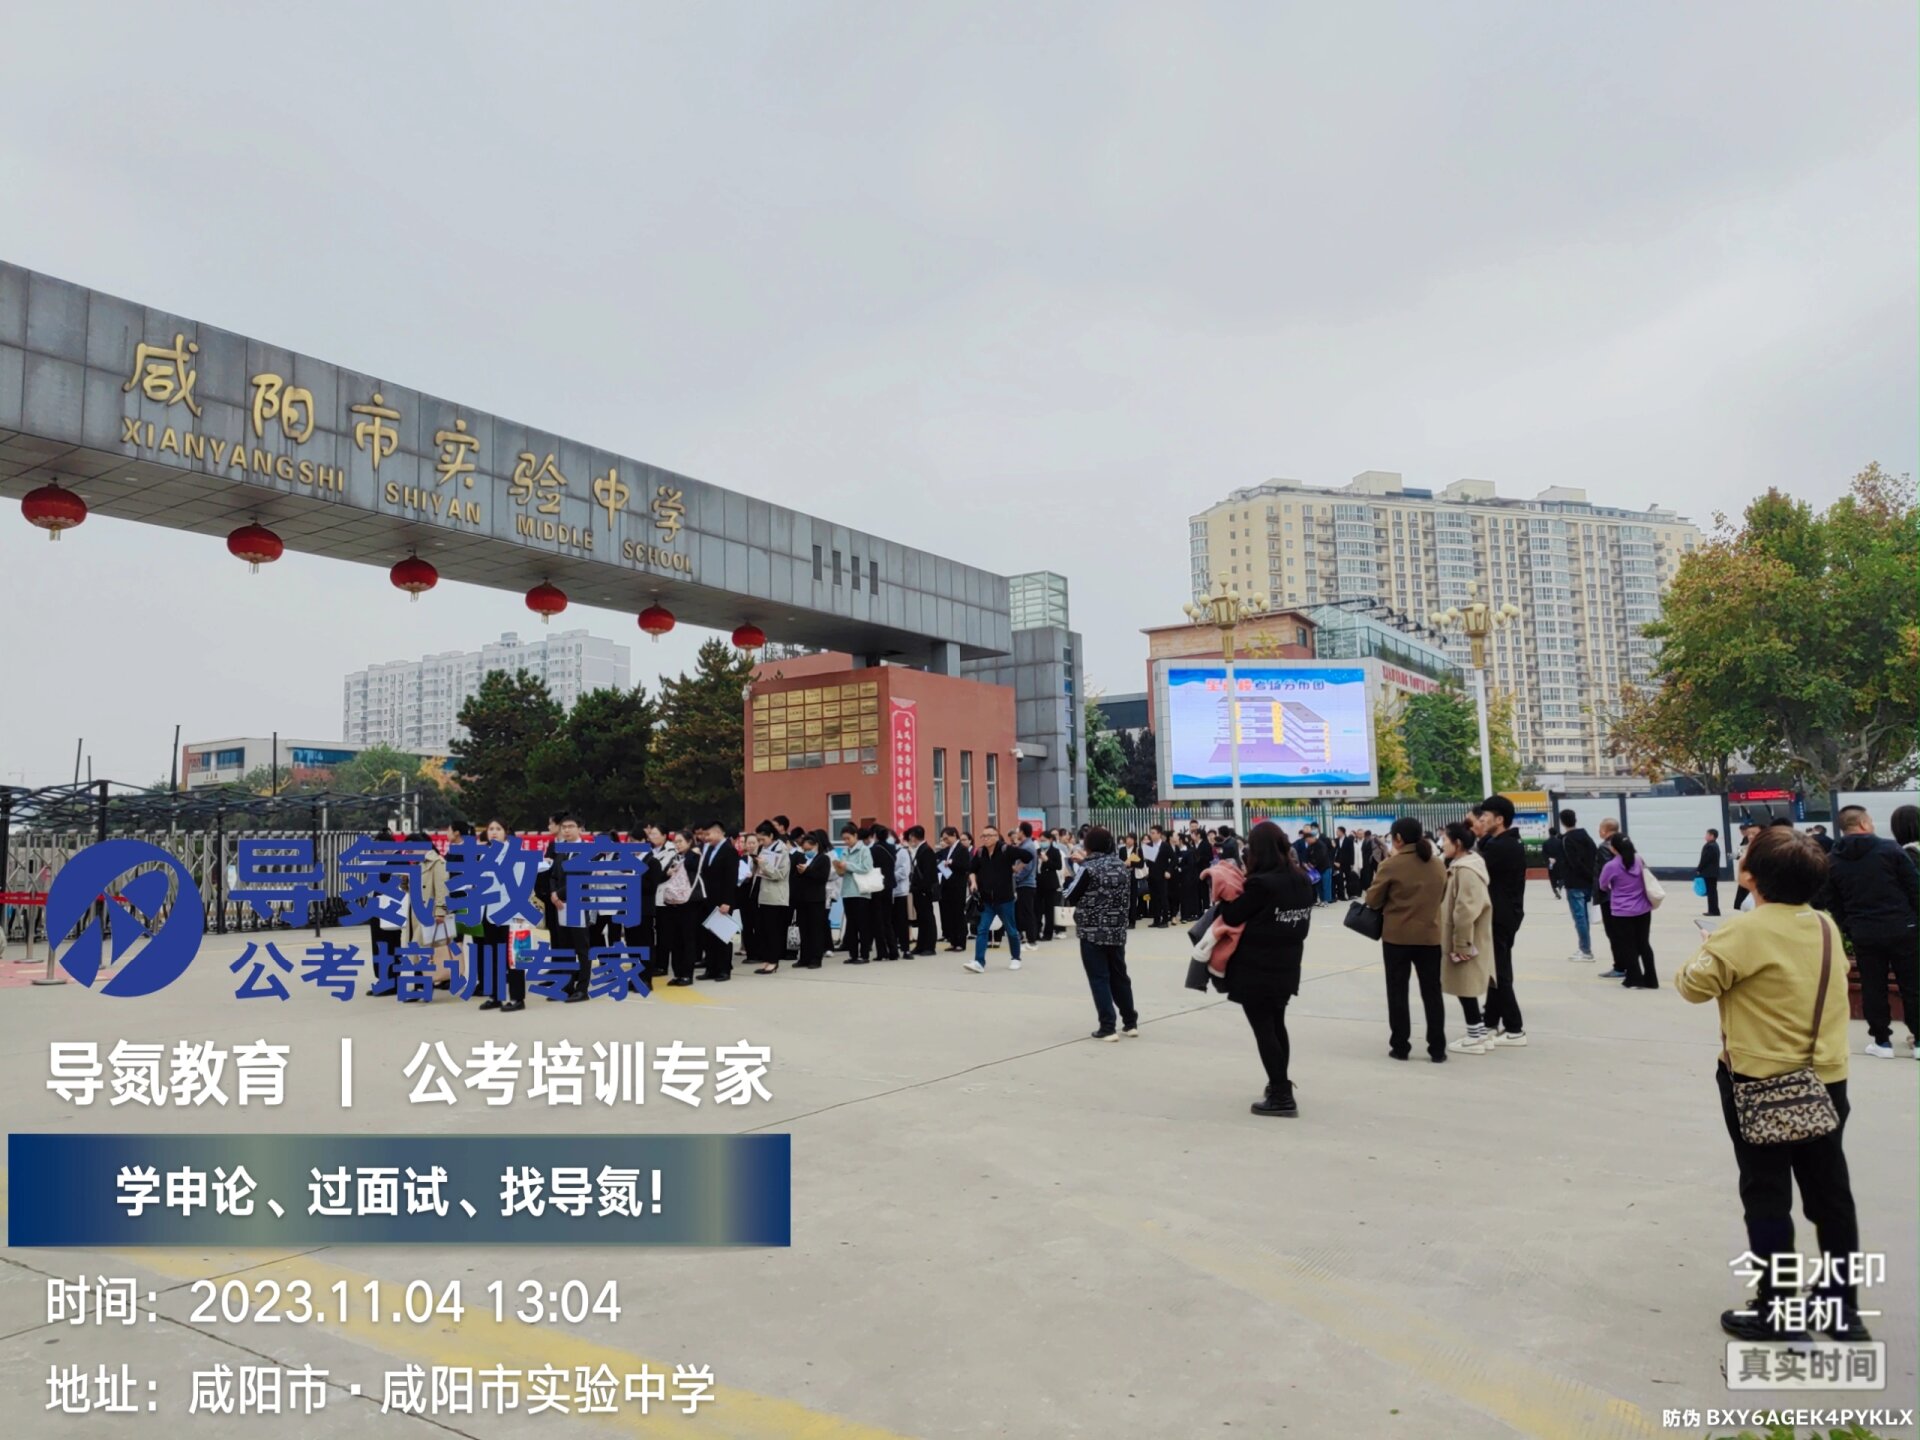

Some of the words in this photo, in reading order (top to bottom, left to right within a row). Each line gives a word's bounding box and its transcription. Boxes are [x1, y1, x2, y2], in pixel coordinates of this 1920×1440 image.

[120, 417, 345, 493] XIANYANGSHI
[385, 482, 481, 525] SHIYAN
[516, 513, 594, 551] MIDDLE
[623, 539, 694, 574] SCHOOL
[123, 333, 687, 542] 咸阳市实验中学
